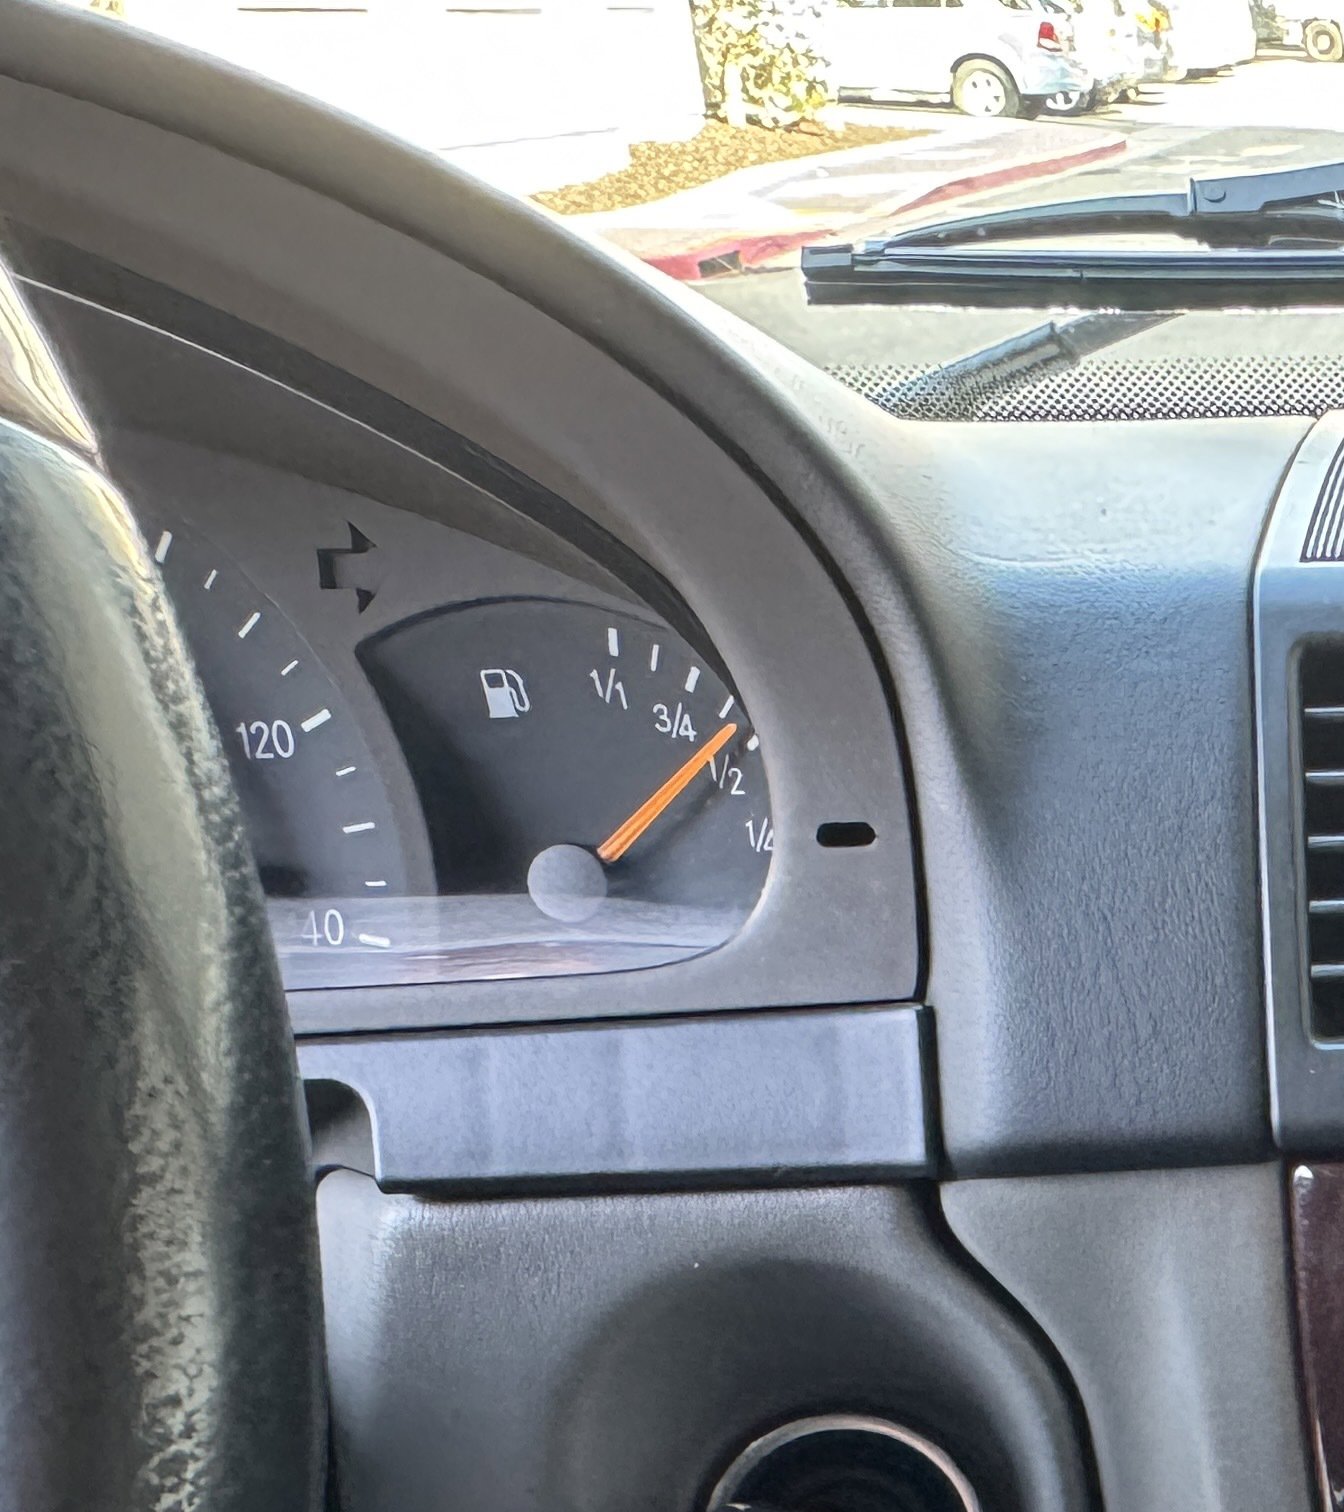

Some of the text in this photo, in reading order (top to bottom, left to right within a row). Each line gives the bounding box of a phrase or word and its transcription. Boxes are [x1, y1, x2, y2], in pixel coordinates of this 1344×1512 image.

[235, 719, 295, 760] 120
[652, 701, 698, 742] 3/4
[708, 753, 746, 795] 1/2
[300, 908, 345, 946] 40
